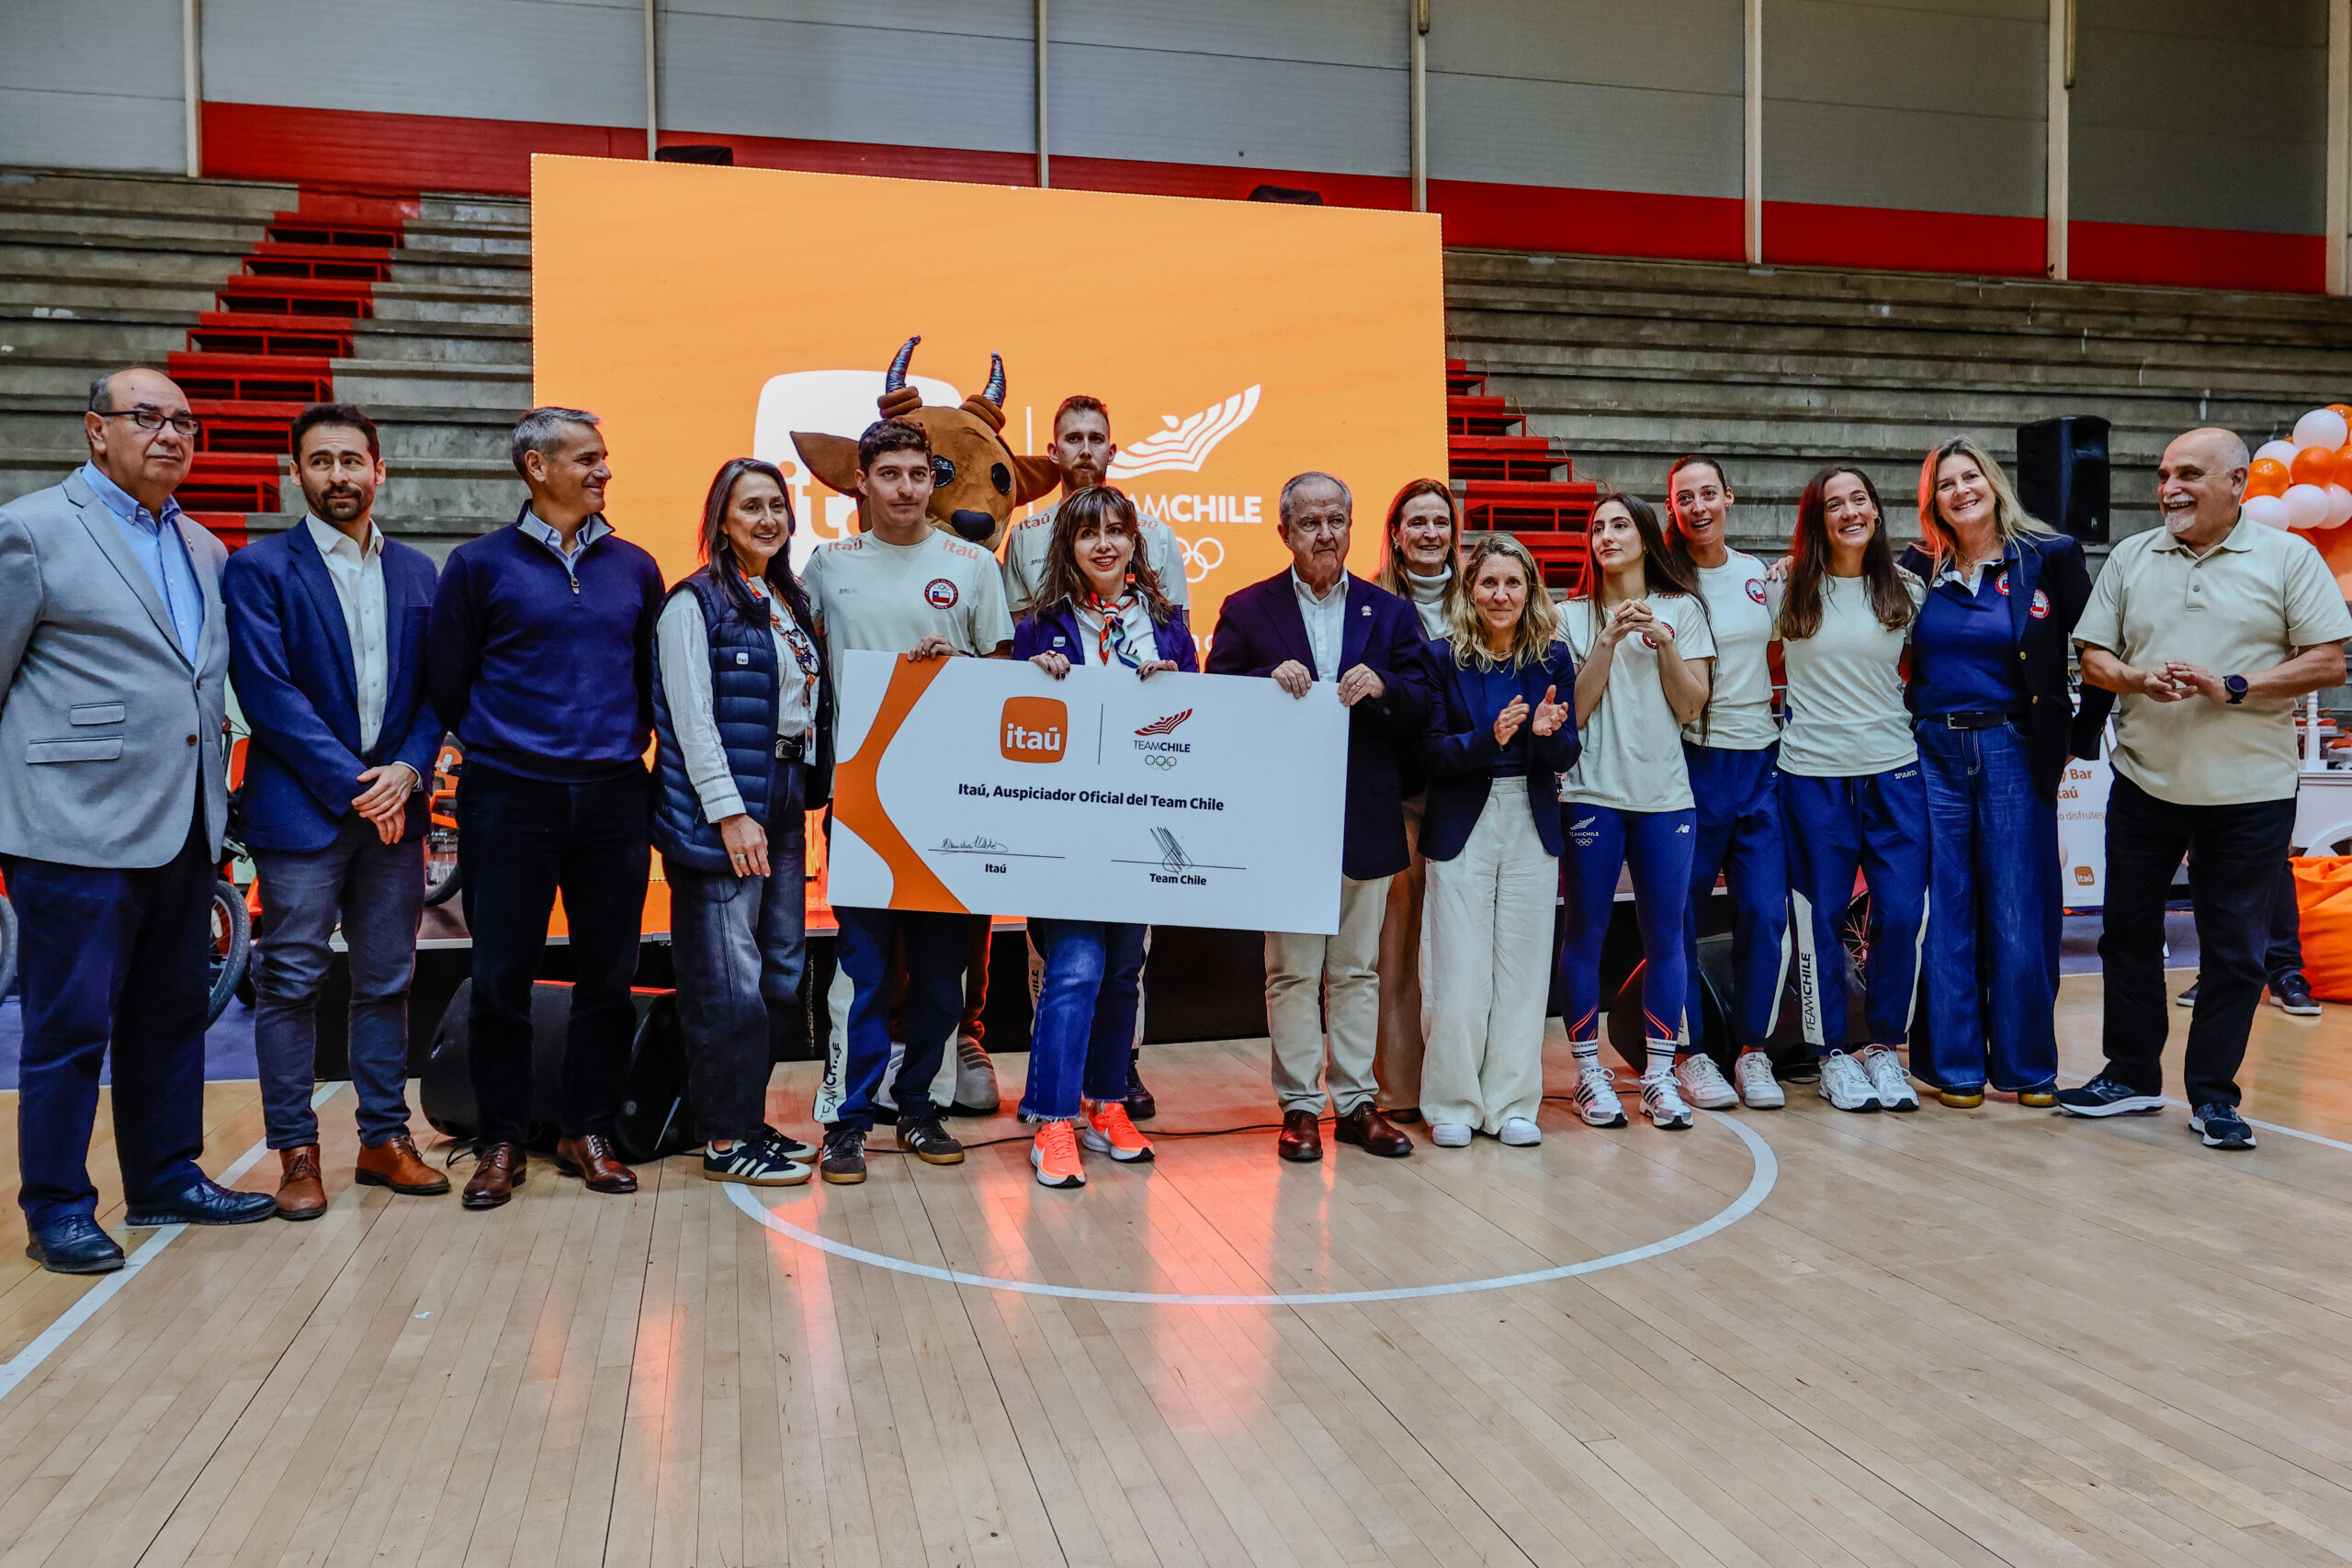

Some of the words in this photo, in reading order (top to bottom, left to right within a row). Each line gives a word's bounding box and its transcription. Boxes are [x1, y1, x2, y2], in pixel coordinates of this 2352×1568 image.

[1127, 493, 1262, 524] AMCHILE
[1019, 513, 1050, 531] itaú
[828, 537, 863, 552] itaú
[942, 539, 980, 560] itaú
[1006, 723, 1060, 751] itaú
[1133, 740, 1191, 753] TEAMCHILE
[2069, 768, 2092, 780] Bar
[958, 784, 989, 797] Itaú,
[993, 785, 1076, 801] Auspiciador
[1079, 790, 1124, 805] Oficial
[1126, 794, 1148, 806] del
[1150, 795, 1187, 808] Team
[1190, 797, 1224, 811] Chile
[2057, 785, 2078, 799] taú
[985, 863, 1007, 874] Itaú
[1149, 874, 1178, 884] Team
[1181, 875, 1206, 886] Chile
[2076, 873, 2094, 883] itaú
[1801, 952, 1815, 1031] TEAMCHILE
